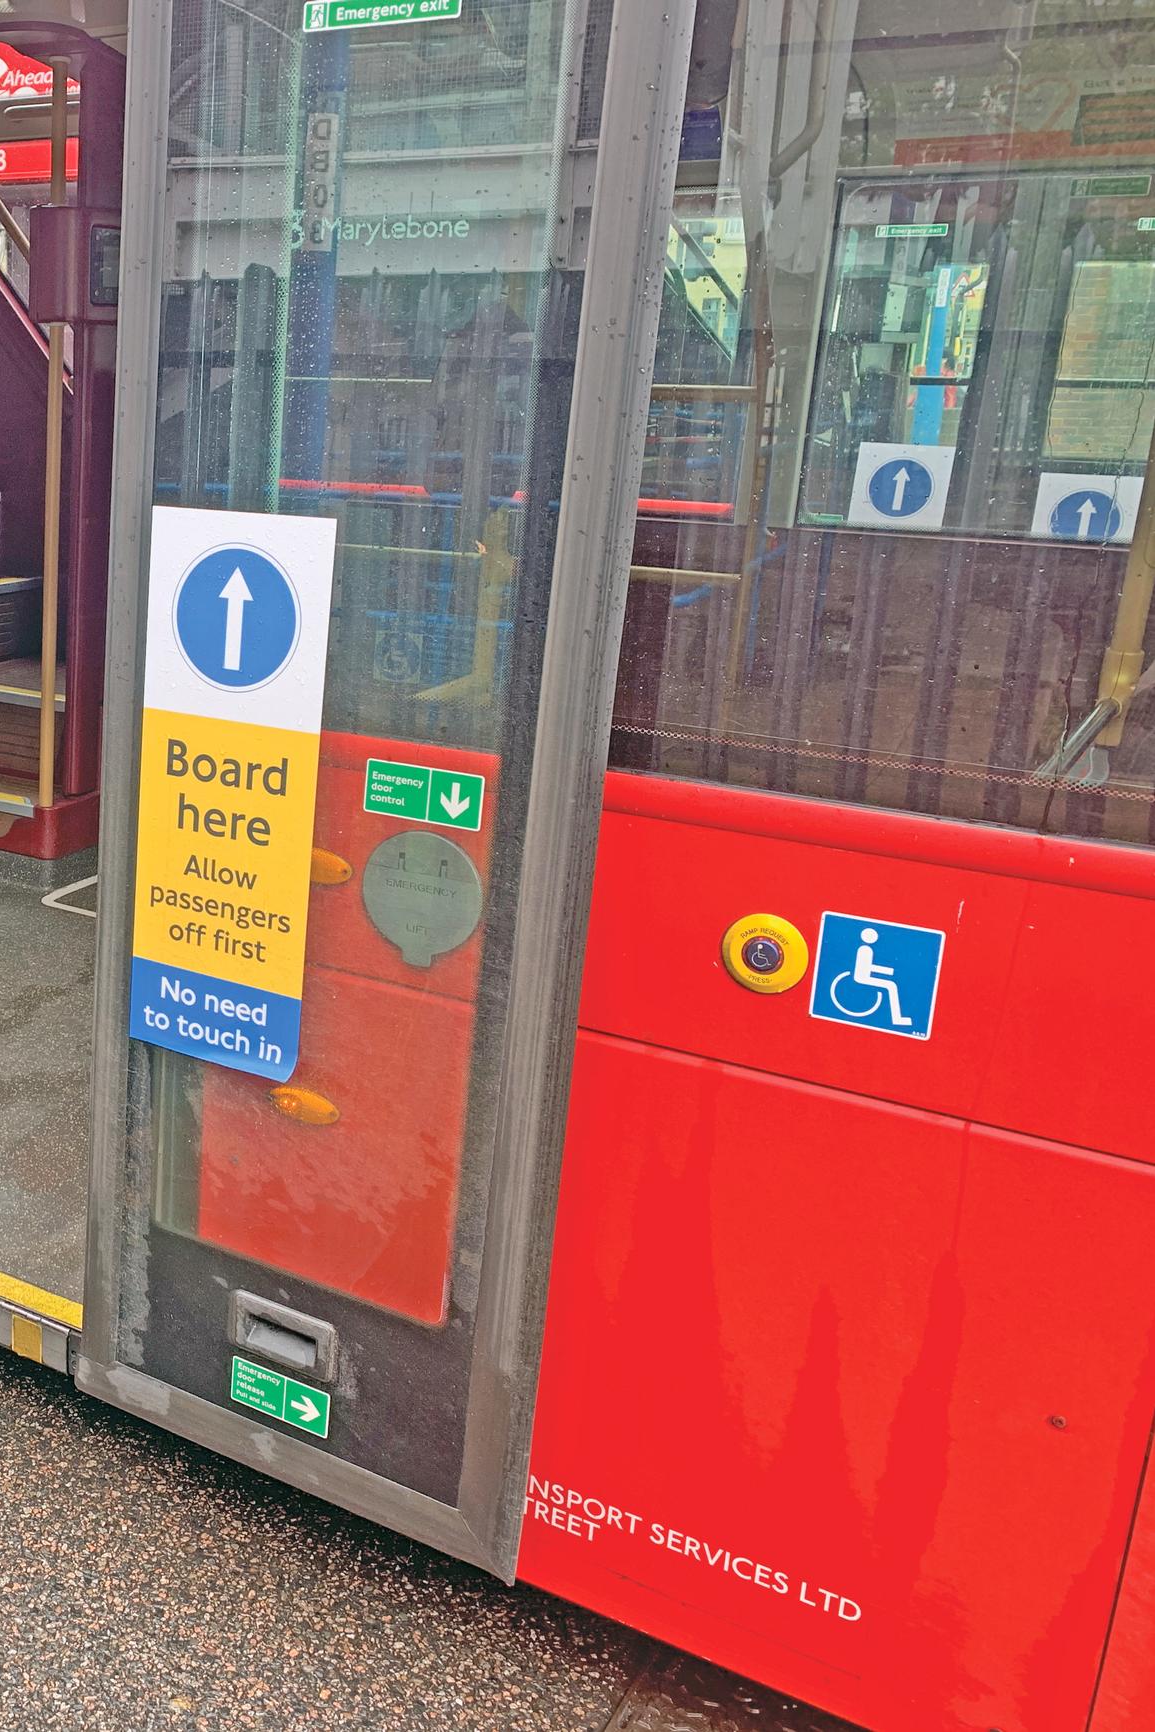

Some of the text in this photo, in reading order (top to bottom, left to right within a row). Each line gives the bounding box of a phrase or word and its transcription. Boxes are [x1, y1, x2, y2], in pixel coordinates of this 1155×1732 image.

[336, 0, 450, 21] Emergency exit
[321, 214, 470, 246] Marylebone
[166, 738, 289, 797] Board
[372, 770, 424, 789] Emergency
[371, 782, 394, 793] door
[370, 793, 406, 807] control
[177, 792, 271, 847] here
[183, 854, 258, 890] Allow
[385, 878, 458, 899] EMERGENCY
[150, 885, 292, 934] passengers
[168, 921, 267, 963] off first
[740, 927, 790, 946] RAMP REQUEST
[160, 975, 268, 1027] No need
[143, 1005, 283, 1065] to touch in
[237, 1362, 280, 1386] Emergency
[237, 1372, 255, 1384] door
[236, 1389, 276, 1411] Pull and slide
[237, 1381, 264, 1396] release
[649, 1522, 789, 1595] SERVICES
[799, 1581, 862, 1622] LTD
